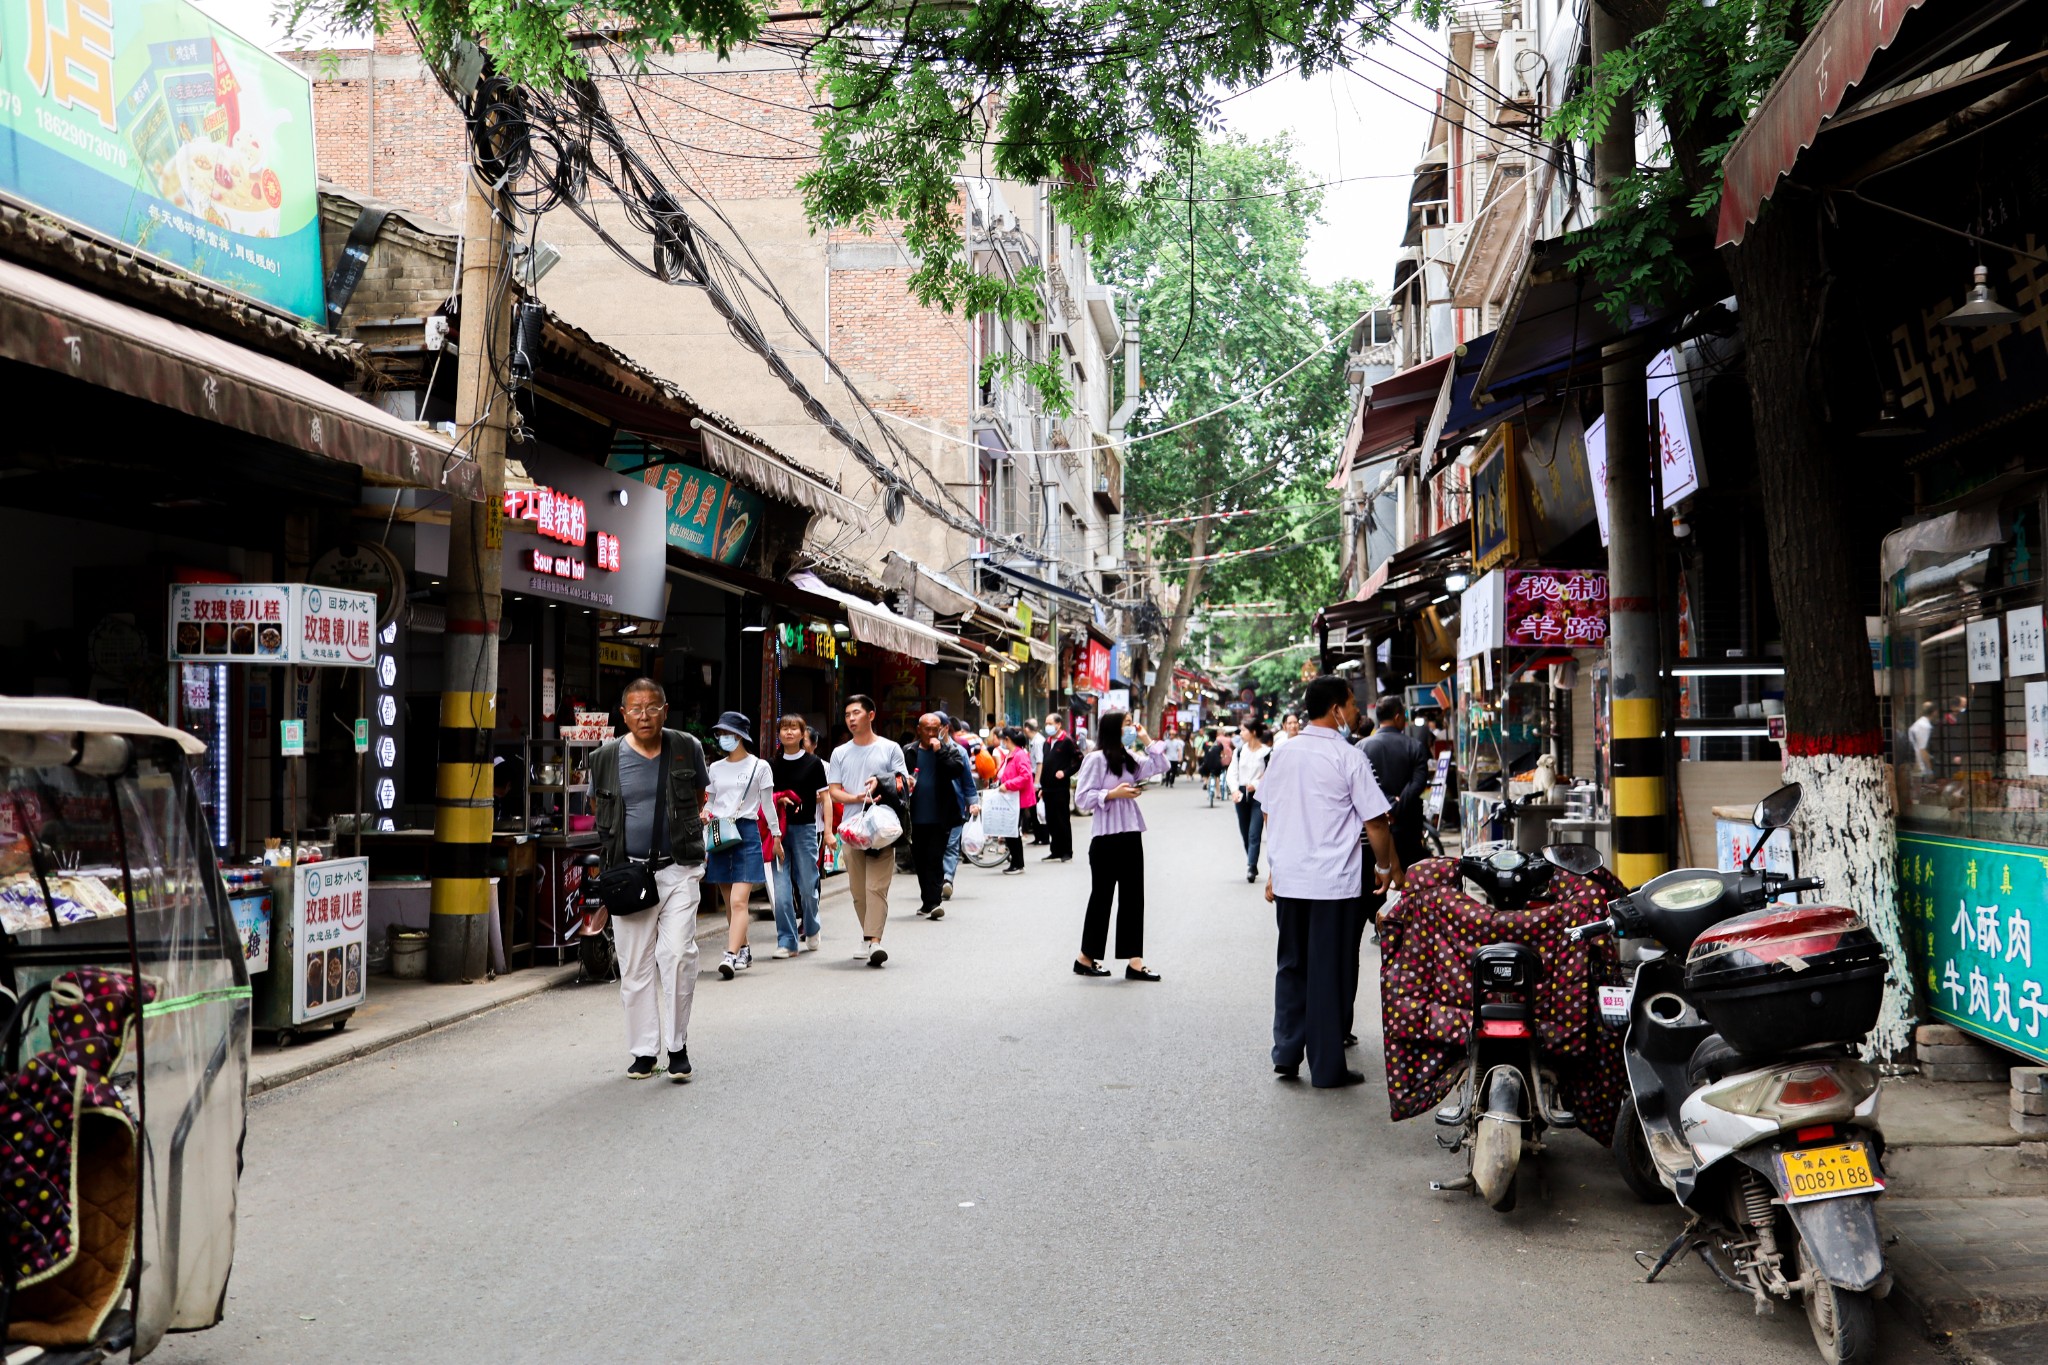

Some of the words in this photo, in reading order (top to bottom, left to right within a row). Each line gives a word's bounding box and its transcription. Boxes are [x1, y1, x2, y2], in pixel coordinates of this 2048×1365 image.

[35, 107, 128, 168] 18629073070
[534, 549, 553, 570] Sour
[555, 556, 571, 577] and
[572, 557, 585, 580] hot
[599, 535, 619, 568] 冒菜
[1517, 575, 1608, 601] 秘制
[193, 599, 281, 621] 玫瑰镜儿糕
[328, 596, 368, 614] 回坊小吃
[304, 614, 371, 655] 玫瑰镜儿糕
[1516, 616, 1607, 641] 羊蹄
[324, 869, 363, 887] 回坊小吃
[1966, 858, 2013, 896] 清真
[305, 889, 364, 930] 玫瑰镜儿糕
[1951, 899, 2031, 968] 小酥肉
[1943, 958, 2048, 1039] 牛肉丸子
